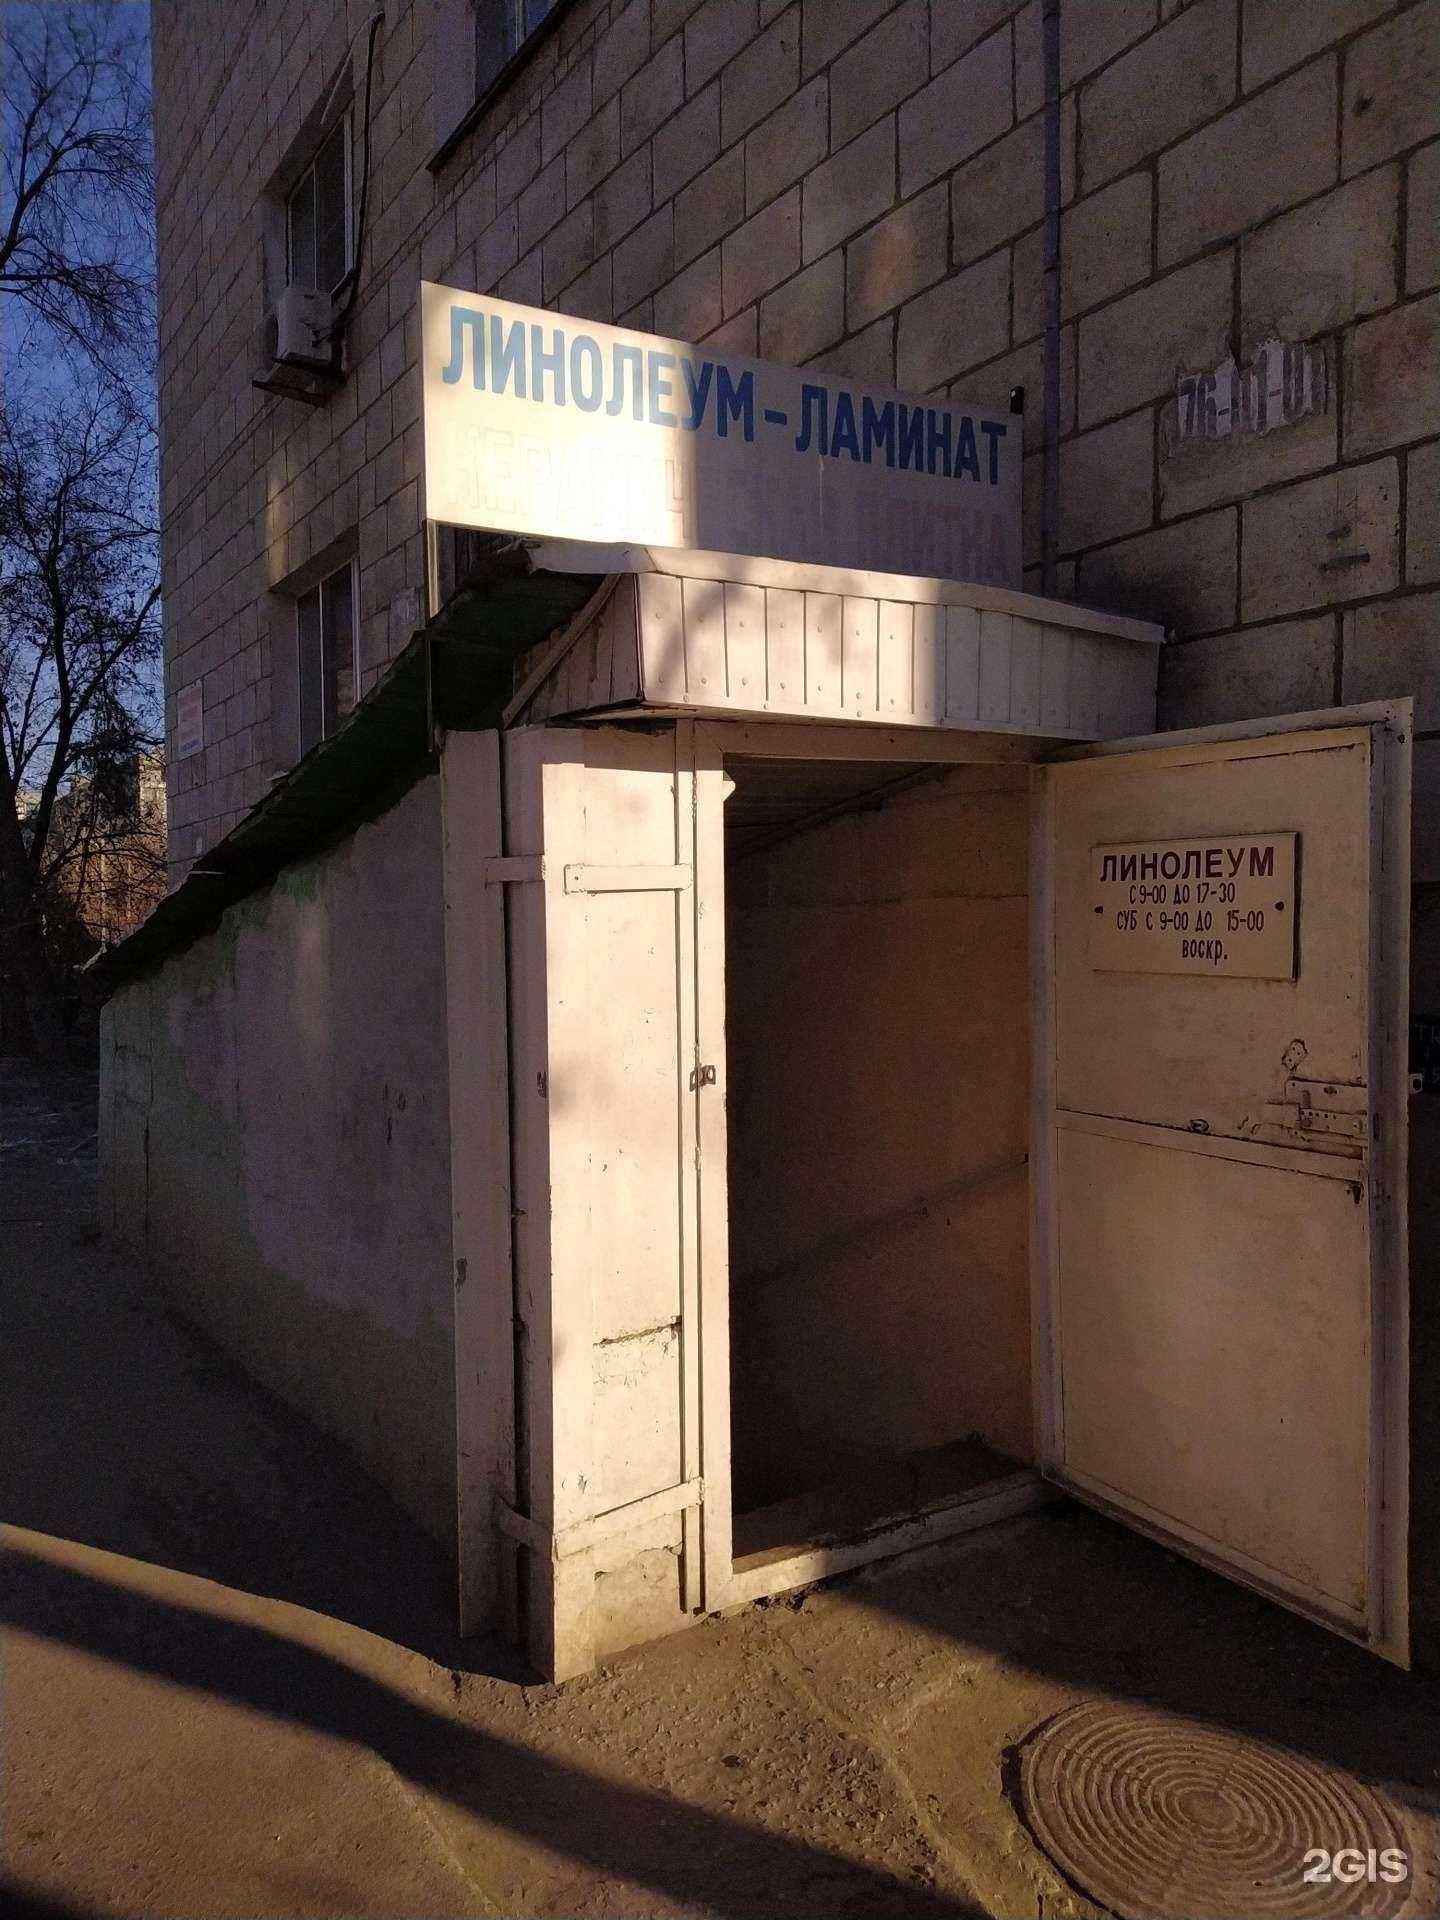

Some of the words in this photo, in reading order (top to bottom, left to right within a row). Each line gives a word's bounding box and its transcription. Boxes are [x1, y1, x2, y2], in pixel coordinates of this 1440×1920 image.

[1101, 846, 1274, 881] ЛИНОЛЕУМ
[1173, 884, 1190, 904] ДО
[1196, 882, 1236, 904] 17-30
[1116, 910, 1137, 930] СУБ
[1146, 911, 1153, 930] С
[1160, 911, 1189, 931] 9-00
[1195, 910, 1212, 931] ДО
[1227, 910, 1264, 931] 15-00
